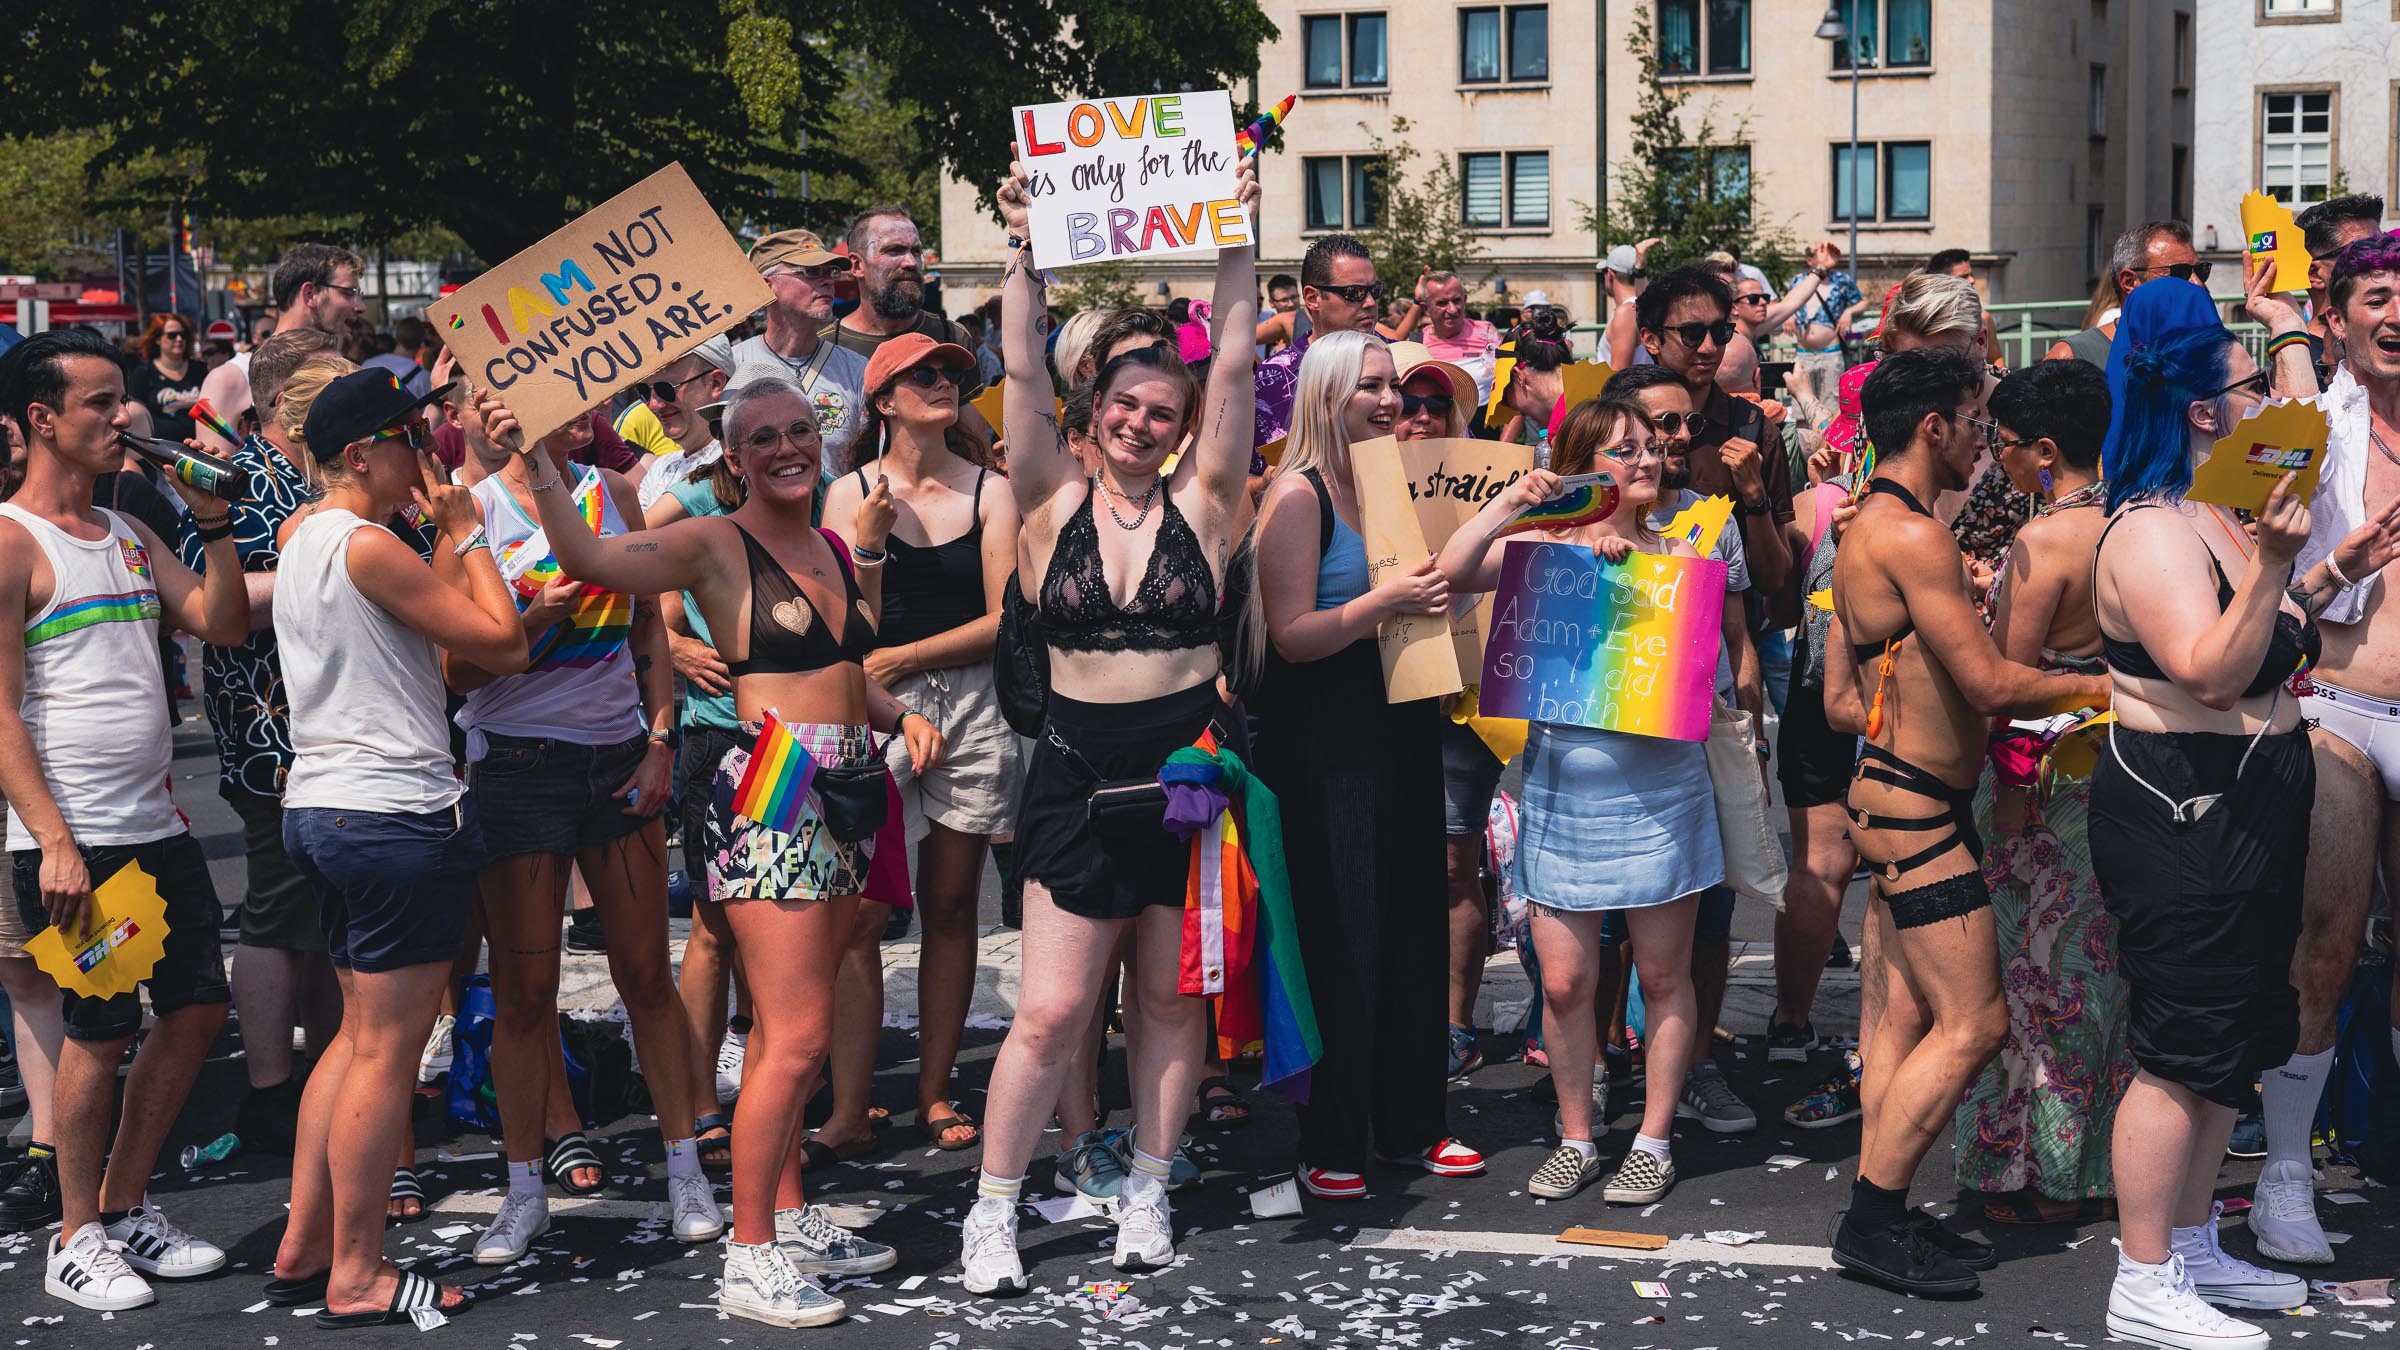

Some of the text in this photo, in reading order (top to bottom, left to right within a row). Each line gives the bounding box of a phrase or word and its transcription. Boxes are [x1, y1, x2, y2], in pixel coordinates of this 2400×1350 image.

[1020, 96, 1186, 157] LOVE
[1027, 139, 1231, 203] is only for the
[1066, 198, 1248, 260] BRAVE
[481, 205, 674, 346] I AM NOT
[485, 272, 682, 391] CONFUSED.
[553, 289, 733, 401] YOU ARE.
[2254, 446, 2309, 468] DHL
[1424, 461, 1529, 513] straig
[1525, 544, 1684, 612] God said
[1492, 595, 1668, 657] Adam + Eve
[1493, 653, 1534, 680] so
[1604, 658, 1660, 697] did
[2312, 685, 2337, 701] OSS
[1538, 683, 1620, 731] both
[2389, 706, 2400, 717] B
[79, 923, 132, 969] DHL
[2280, 1070, 2308, 1080] PROUD
[74, 1235, 90, 1248] adidas
